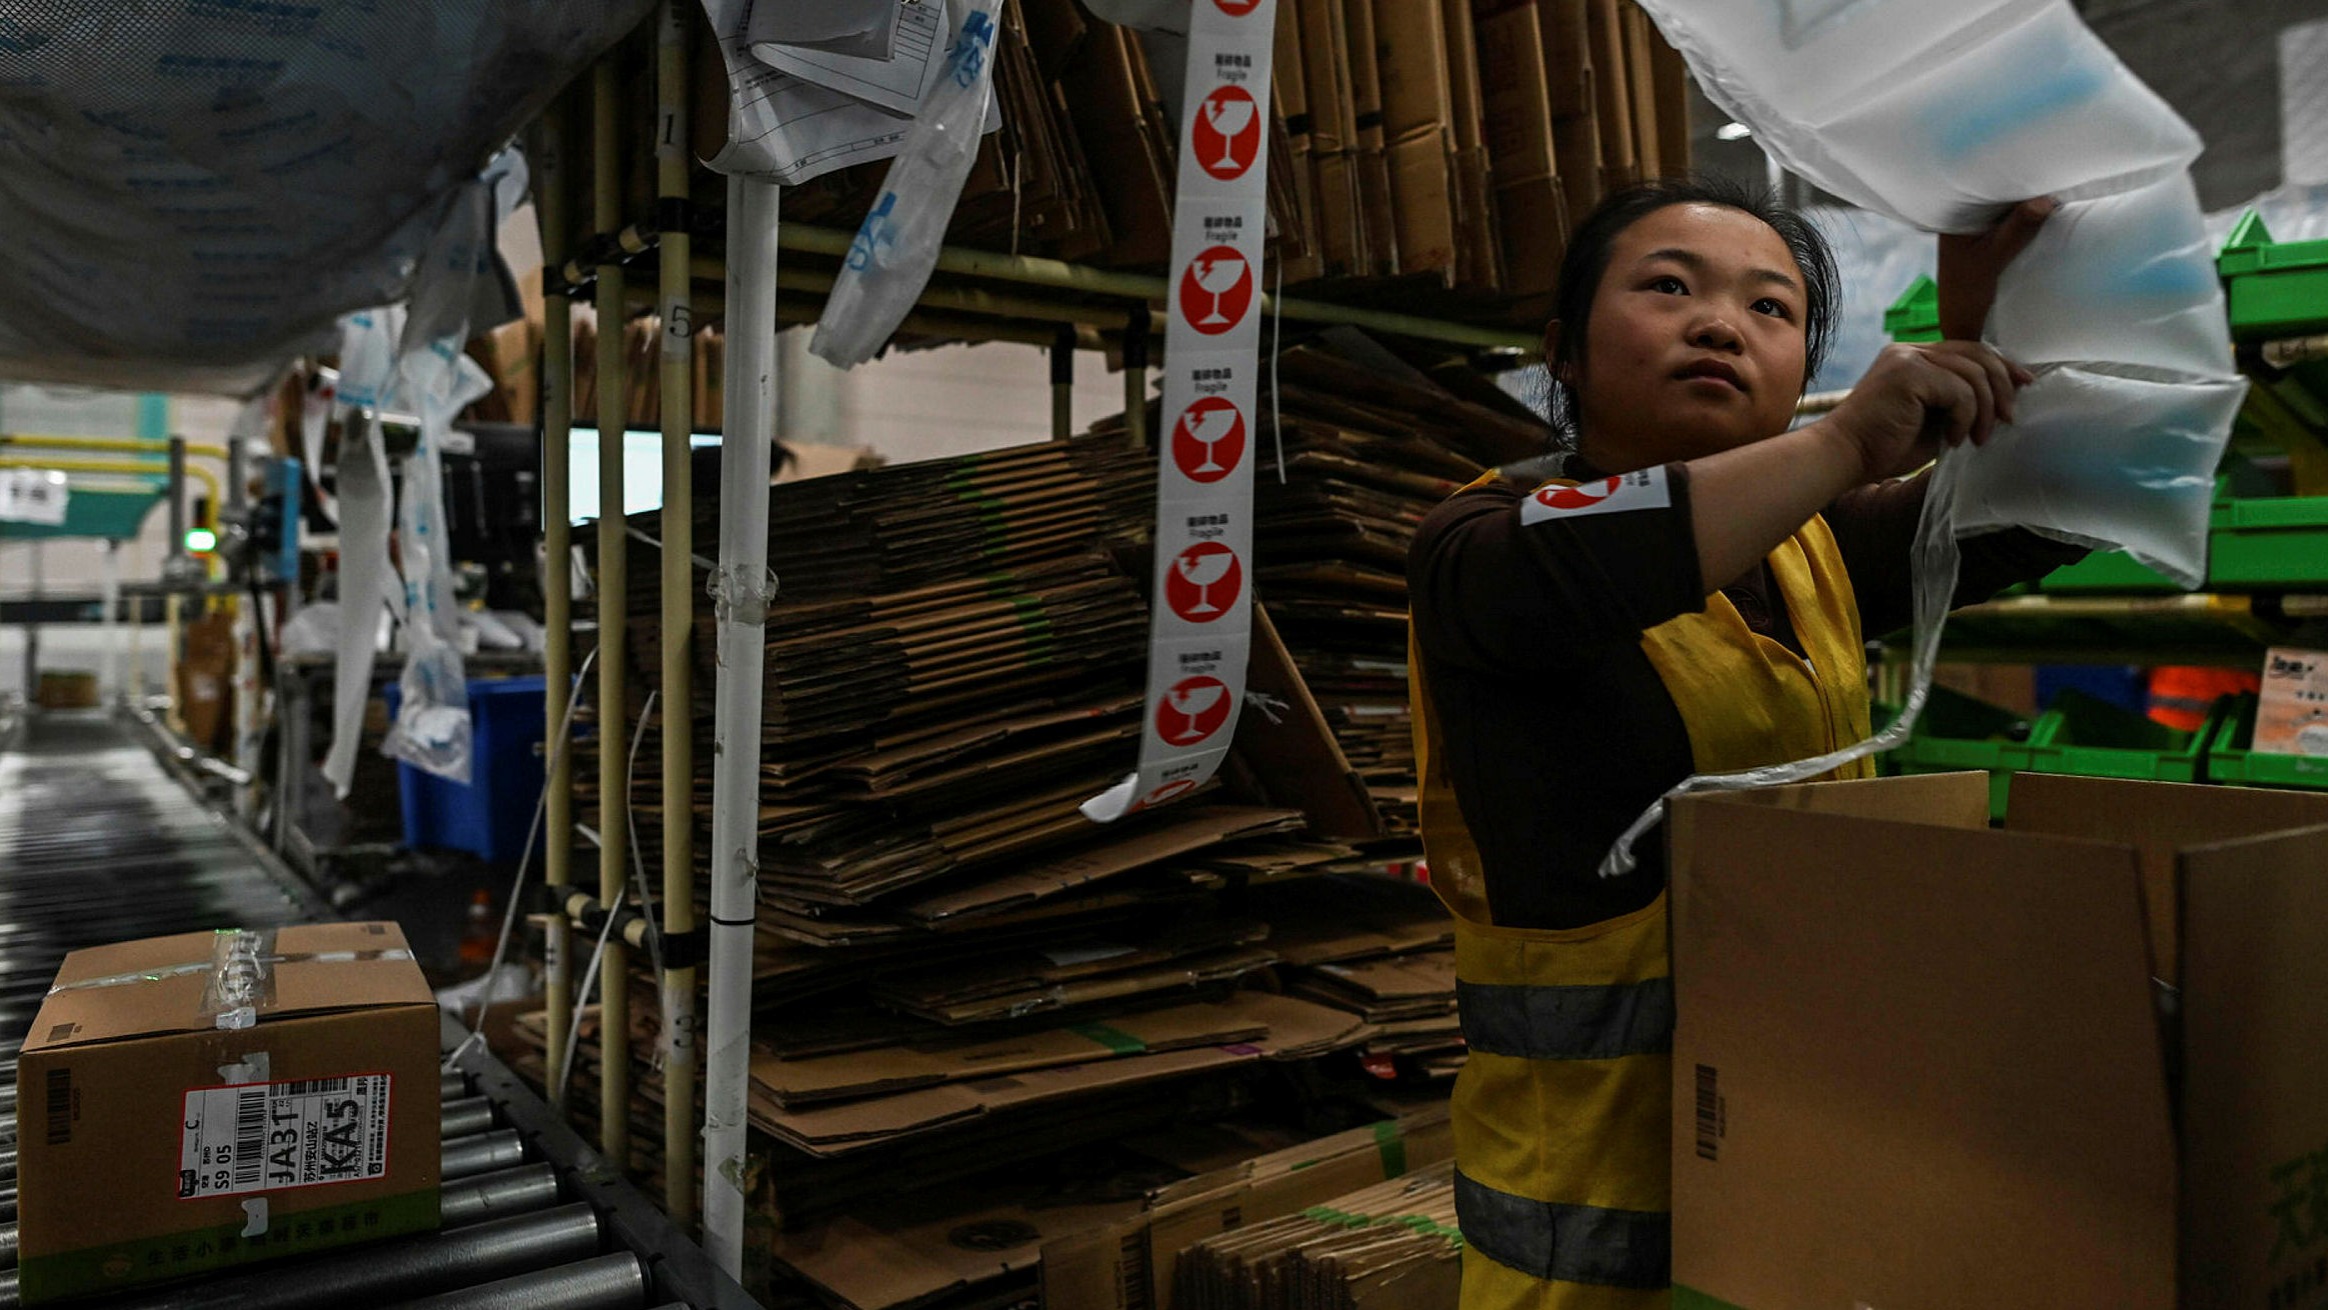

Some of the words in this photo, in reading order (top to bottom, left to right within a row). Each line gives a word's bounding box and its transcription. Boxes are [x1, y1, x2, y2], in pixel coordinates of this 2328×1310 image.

[1217, 69, 1247, 83] Fragile
[1206, 230, 1238, 243] Fragile
[669, 305, 692, 338] 5
[1195, 381, 1227, 395] Fragile
[1189, 527, 1224, 540] Fragile
[185, 1119, 200, 1130] C
[320, 1099, 359, 1175] KA5
[216, 1144, 232, 1164] 05
[268, 1112, 299, 1185] JA31
[214, 1170, 230, 1190] S9
